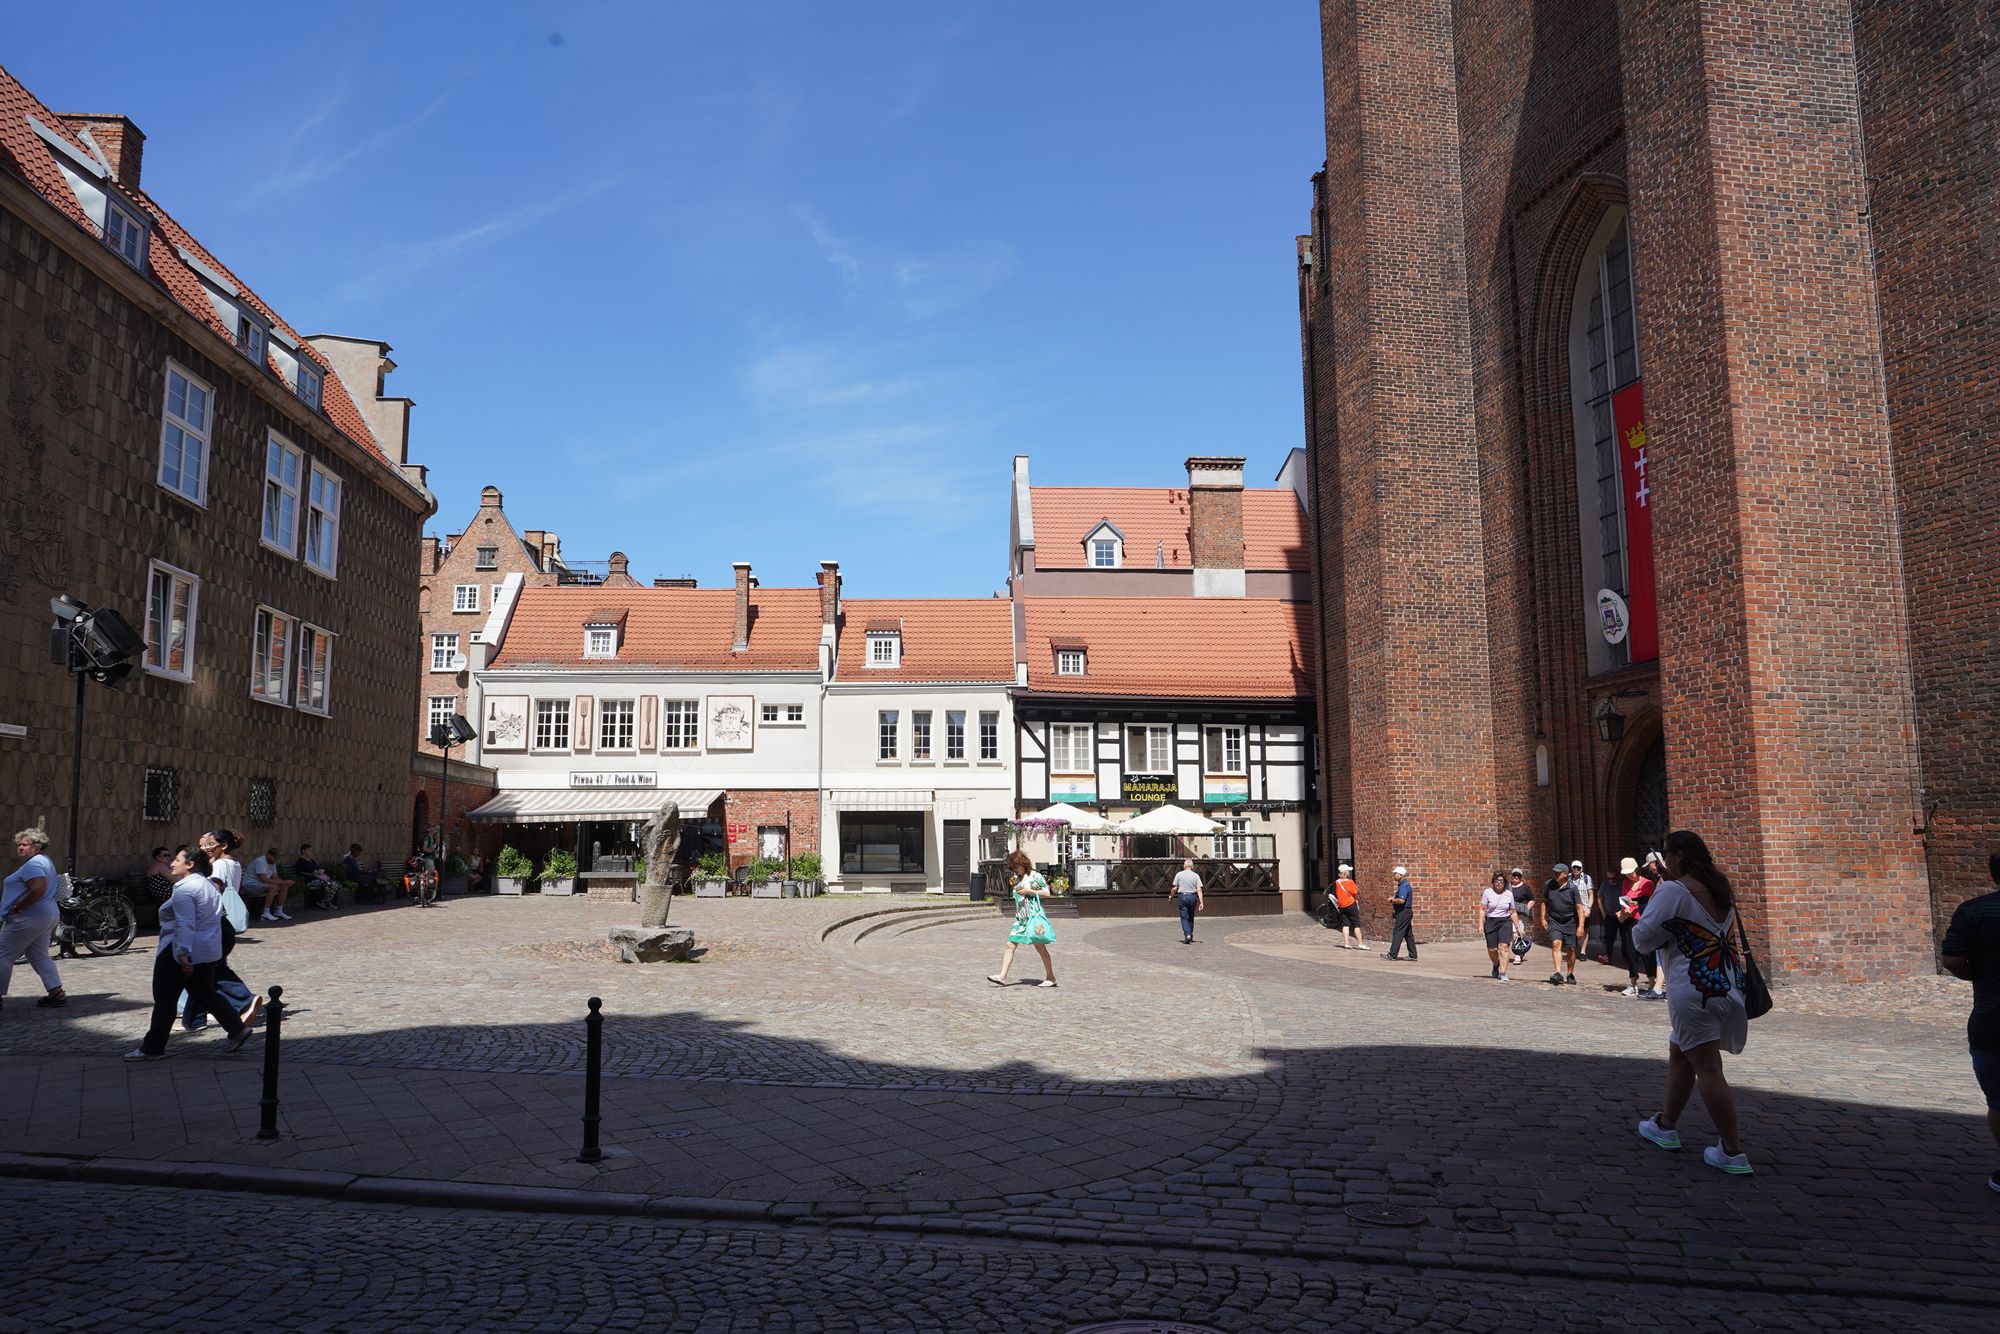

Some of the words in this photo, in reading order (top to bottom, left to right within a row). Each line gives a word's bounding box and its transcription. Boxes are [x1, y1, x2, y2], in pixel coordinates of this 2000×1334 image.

[574, 774, 593, 784] Piwna
[596, 774, 603, 784] 47
[614, 774, 630, 784] Food
[631, 774, 636, 784] &
[638, 774, 653, 784] Wine
[1123, 783, 1177, 792] MAHARAJA
[1130, 793, 1166, 801] LOUNGE
